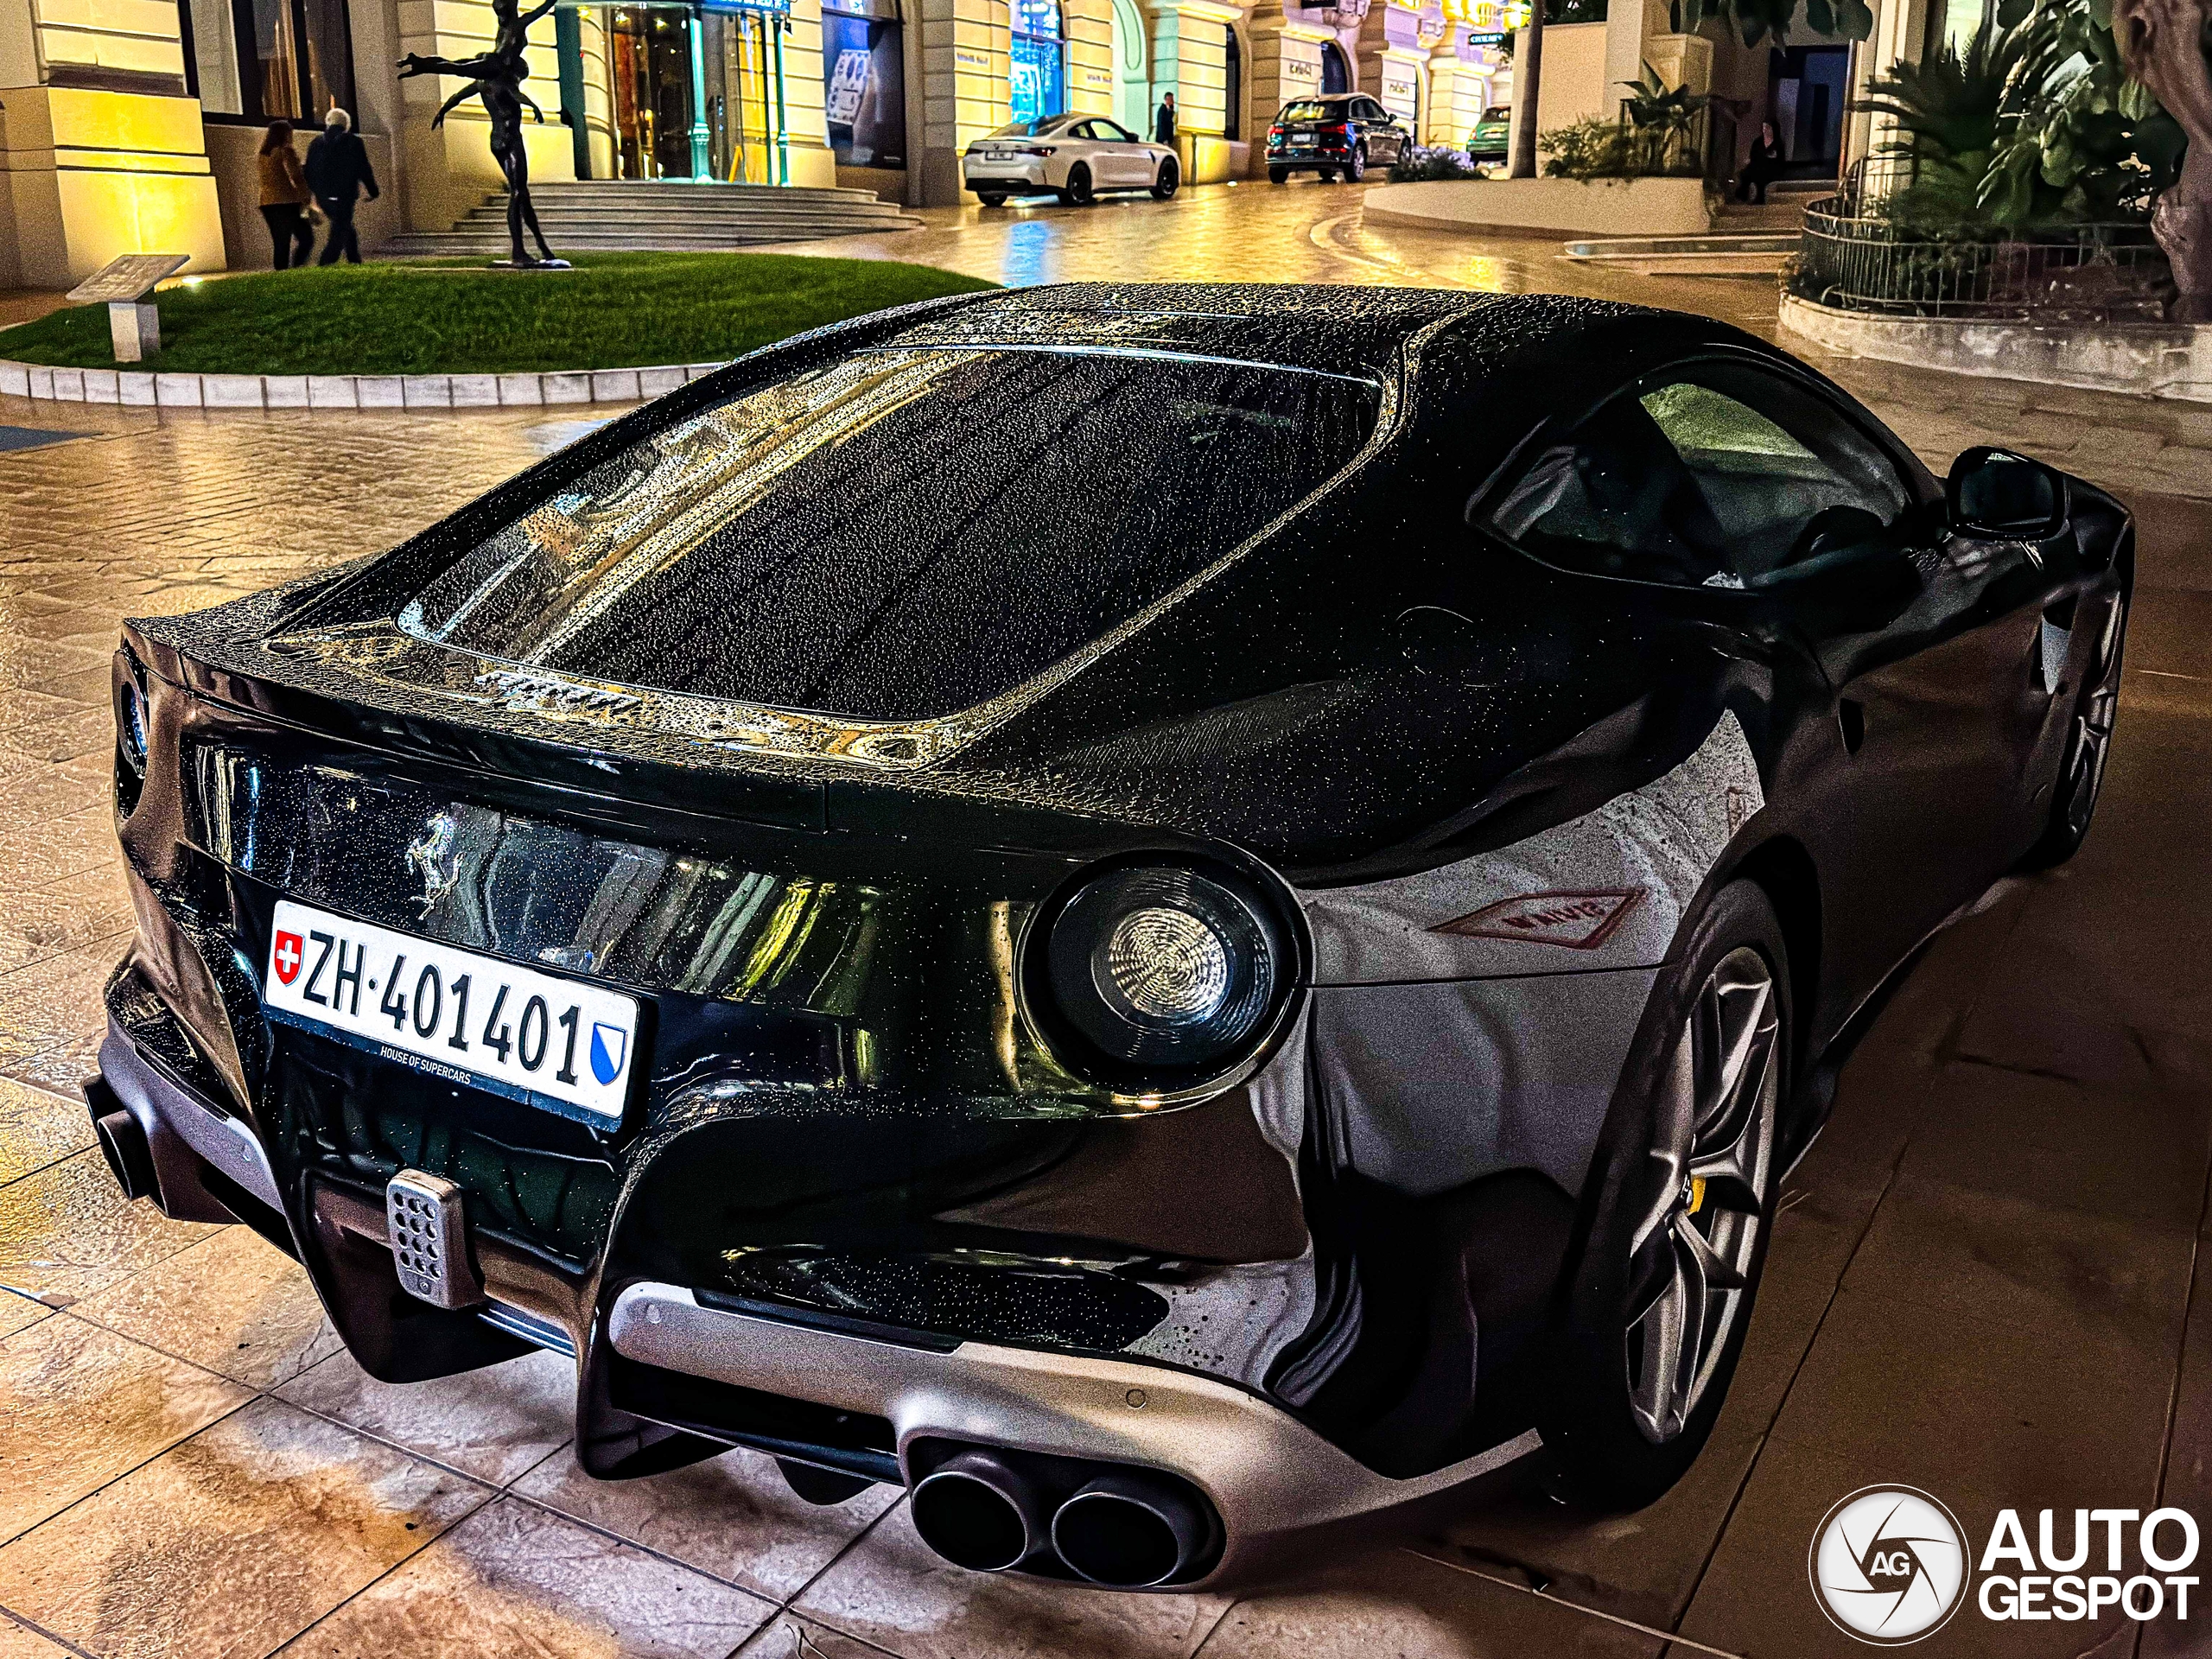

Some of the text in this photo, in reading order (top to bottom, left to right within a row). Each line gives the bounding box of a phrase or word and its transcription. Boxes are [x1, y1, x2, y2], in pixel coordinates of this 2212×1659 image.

[380, 1046, 471, 1084] HOUSE OF SUPERCARS
